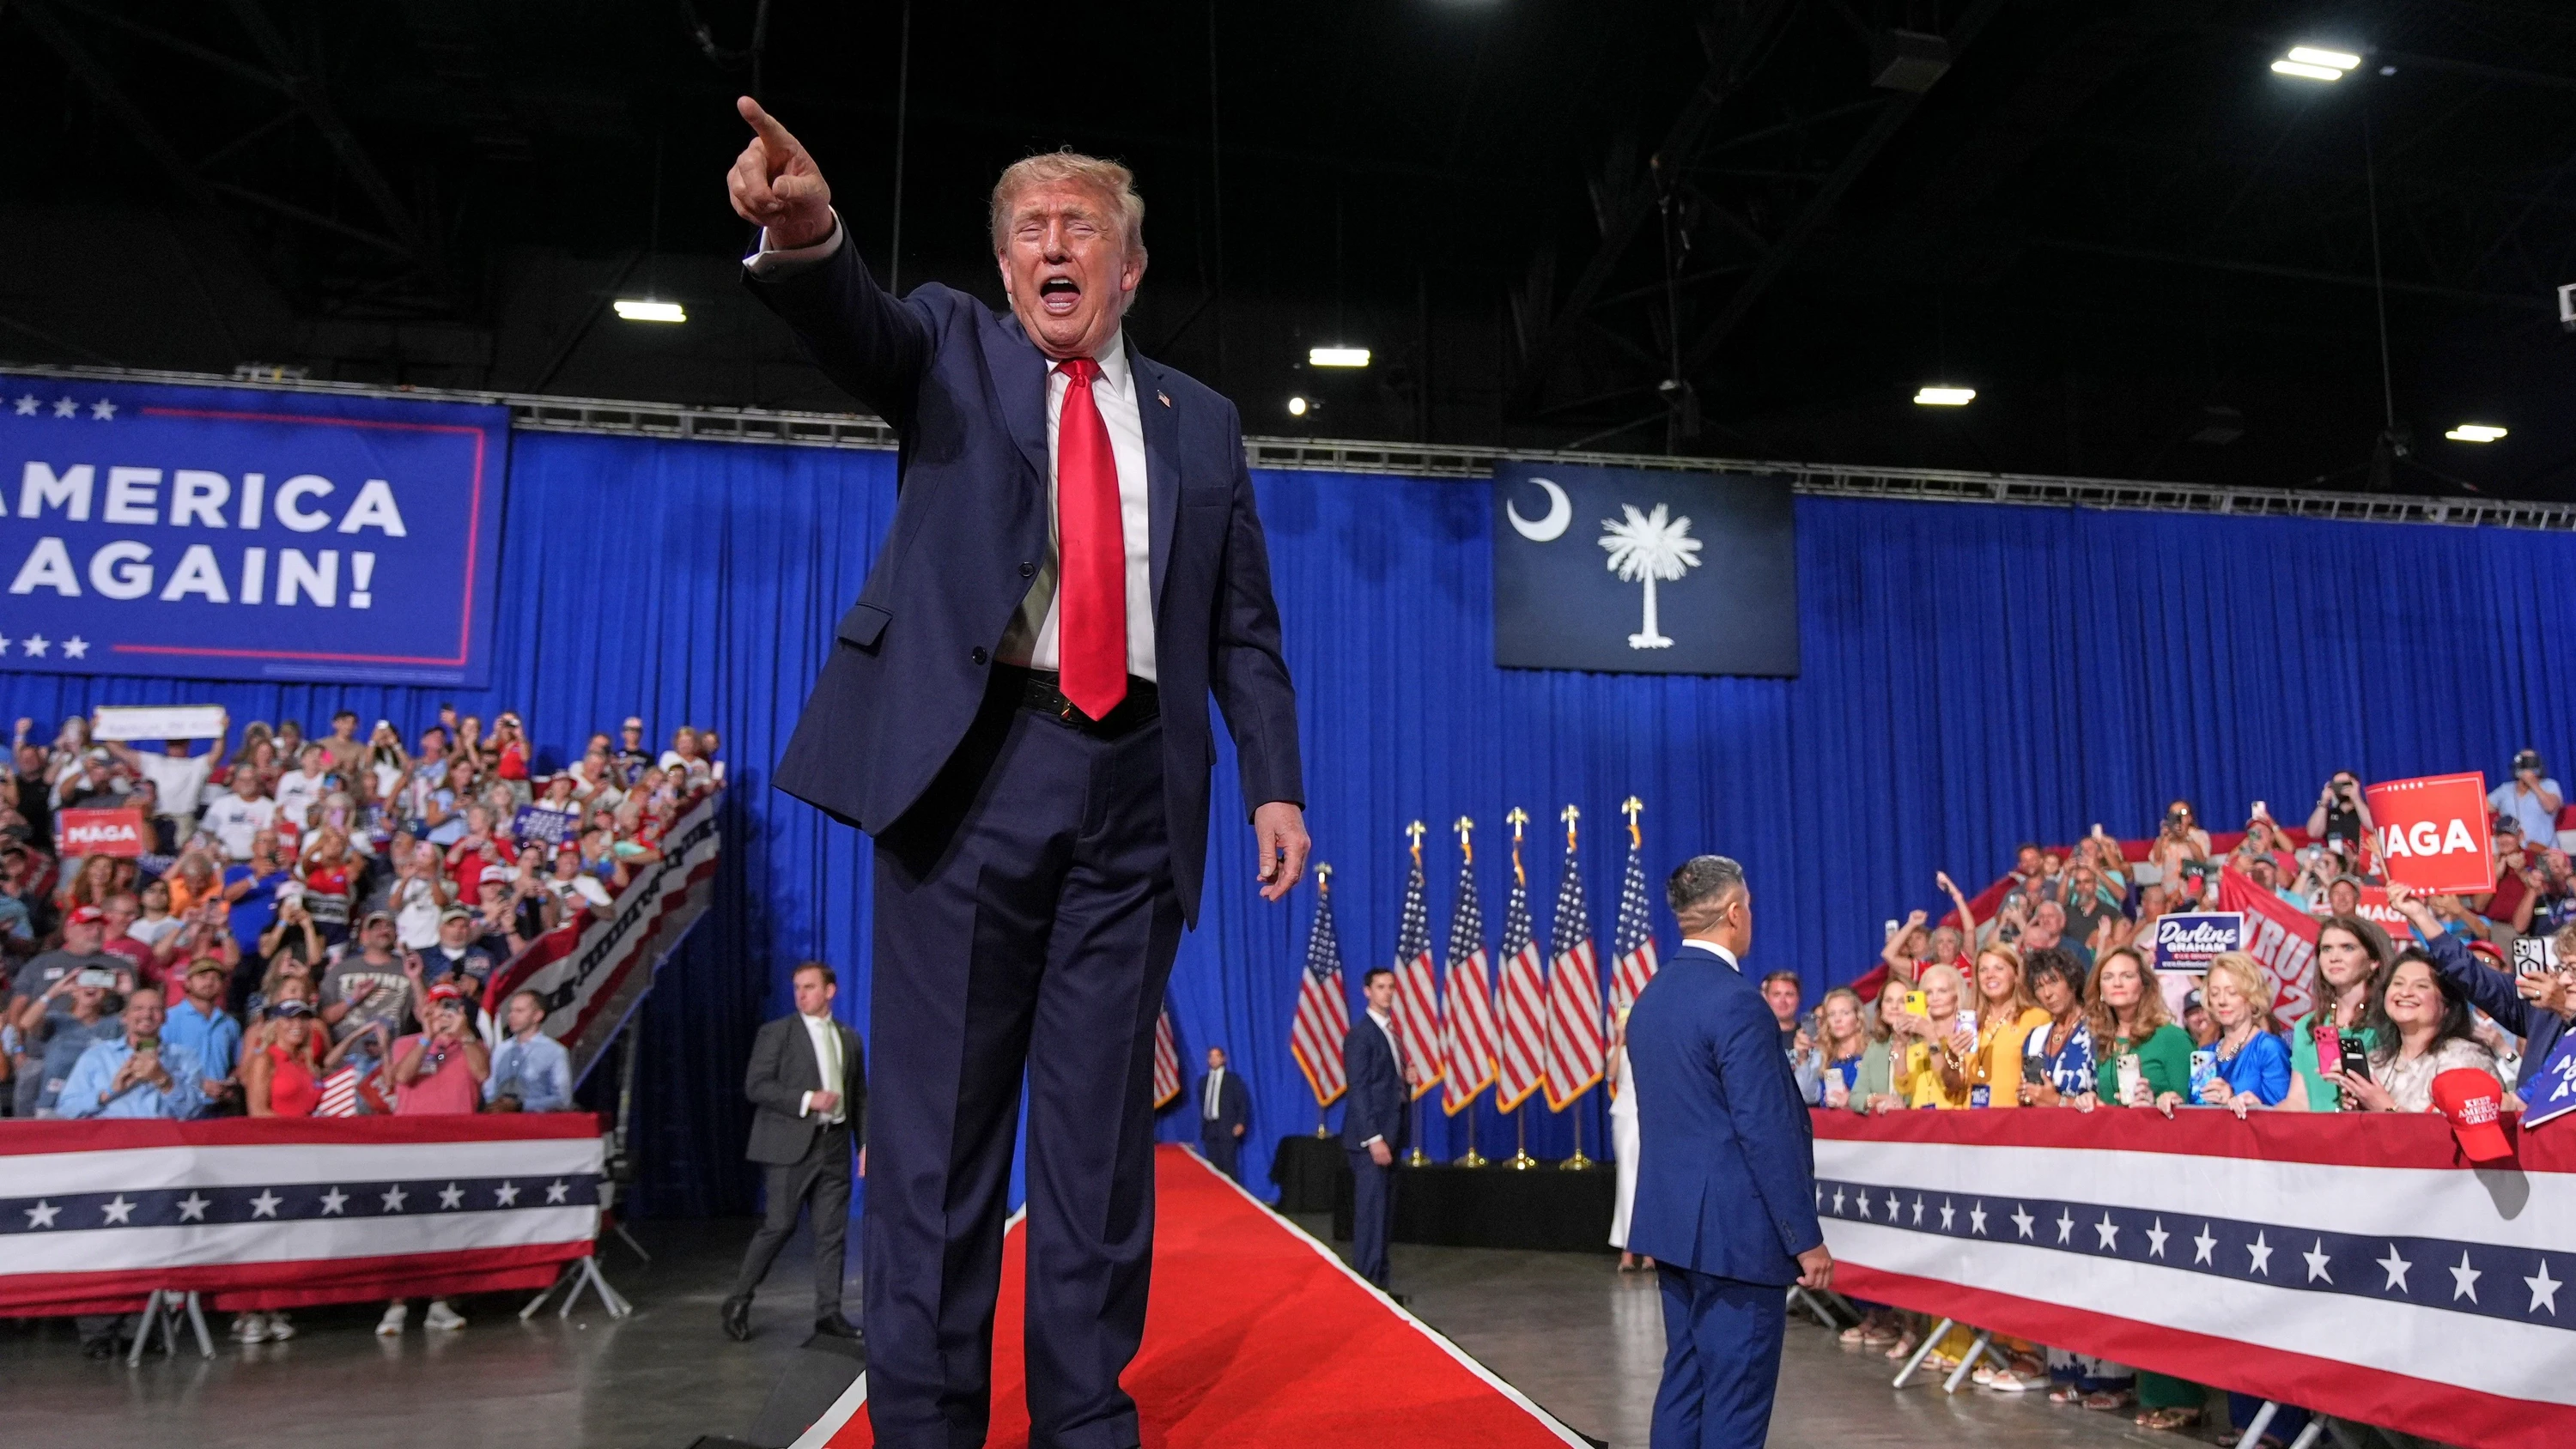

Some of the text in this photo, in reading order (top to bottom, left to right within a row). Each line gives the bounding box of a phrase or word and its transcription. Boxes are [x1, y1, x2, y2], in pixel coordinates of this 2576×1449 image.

[0, 462, 406, 537] MERICA
[9, 537, 375, 609] AGAIN!
[68, 824, 137, 844] MAGA
[2355, 904, 2408, 923] MAG
[2159, 921, 2237, 944] Darline
[2166, 942, 2227, 953] GRAHAM
[2458, 1102, 2499, 1119] AMERICA
[2464, 1095, 2491, 1108] KEEP
[2465, 1110, 2497, 1125] GREAT
